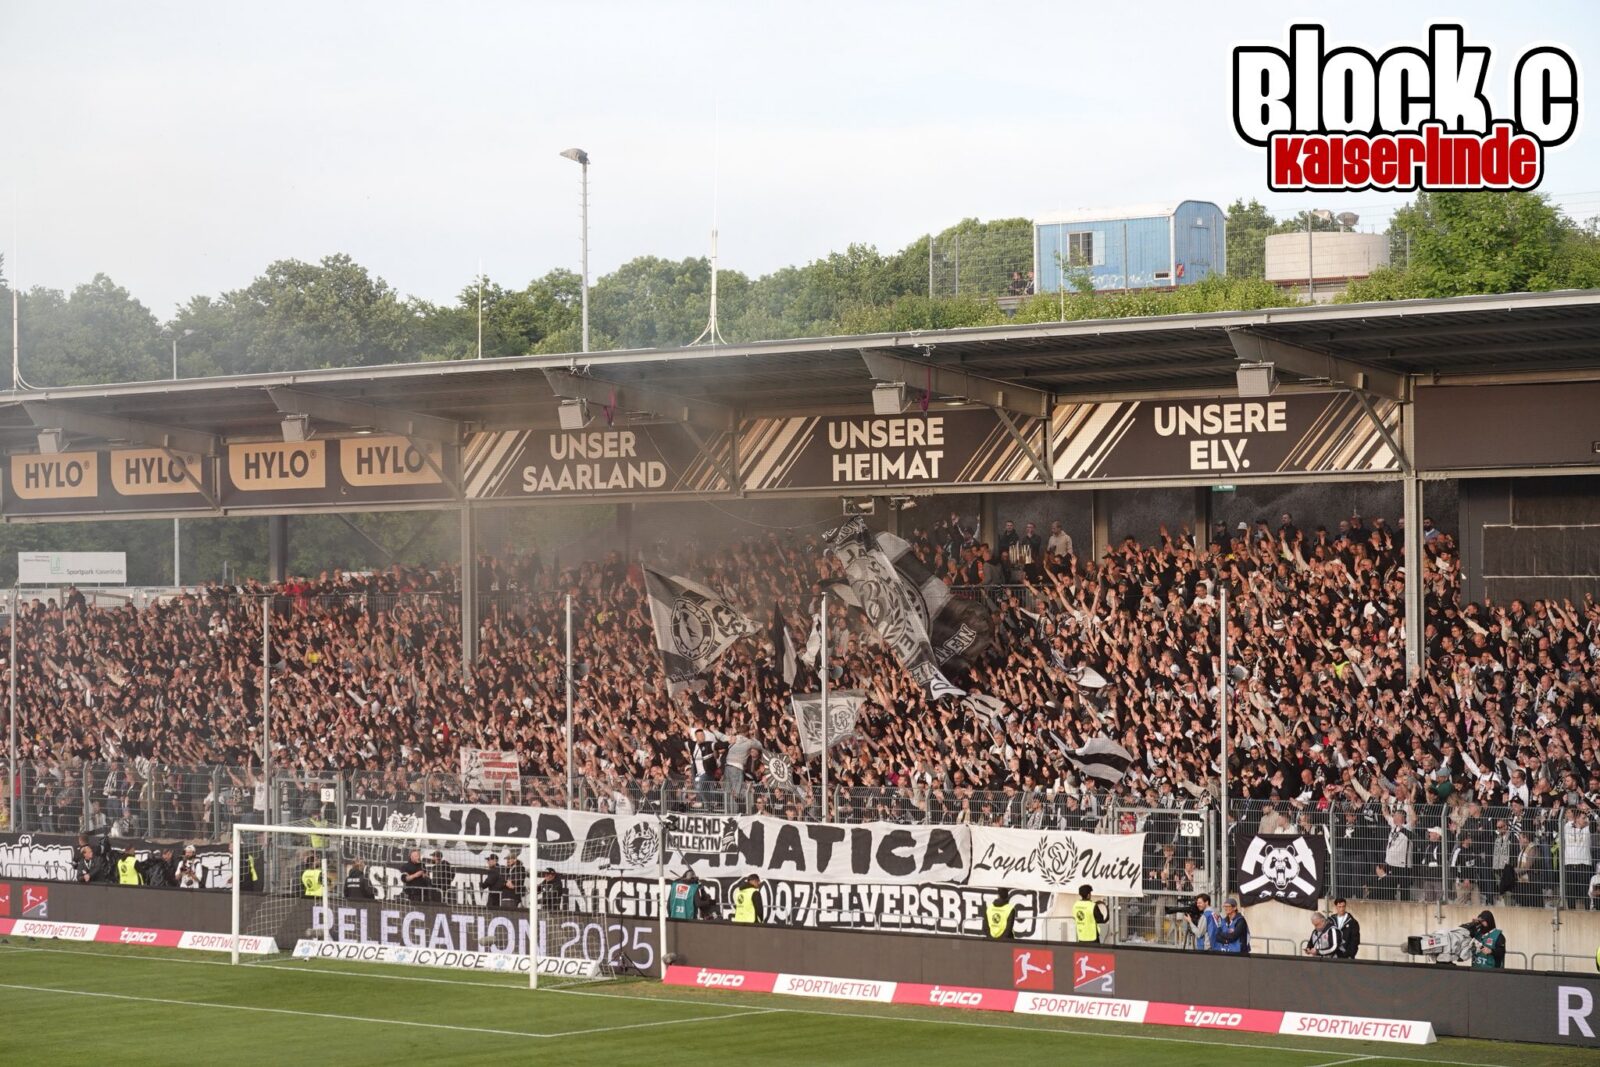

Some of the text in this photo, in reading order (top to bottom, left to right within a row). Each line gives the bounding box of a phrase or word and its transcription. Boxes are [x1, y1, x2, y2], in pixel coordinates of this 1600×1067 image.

[1154, 401, 1287, 436] UNSERE
[828, 417, 945, 449] UNSERE
[549, 431, 637, 460] UNSER
[1190, 439, 1250, 473] ELV.
[522, 461, 667, 492] SAARLAND
[832, 450, 944, 482] HEIMAT
[324, 790, 332, 801] 9
[344, 805, 389, 832] ELV
[666, 816, 721, 834] UGEND
[1186, 821, 1195, 836] 8
[666, 834, 721, 851] KOLLEKTIV
[973, 842, 1037, 879] Loyal
[1077, 848, 1141, 888] Unity
[818, 884, 1035, 935] ELVERSBEG
[21, 923, 88, 938] SPORTWETTEN
[119, 928, 157, 944] tipico
[312, 906, 654, 969] RELEGATION 2025
[316, 943, 388, 961] ICYDICE
[413, 950, 488, 969] ICYDICE
[696, 968, 745, 987] tipico
[786, 978, 881, 997] SPORTWETTEN
[929, 985, 983, 1006] tipico
[1028, 997, 1131, 1018] SPORTWETTEN
[1183, 1006, 1242, 1027] tipico
[1296, 1016, 1412, 1039] SPORTWETTEN
